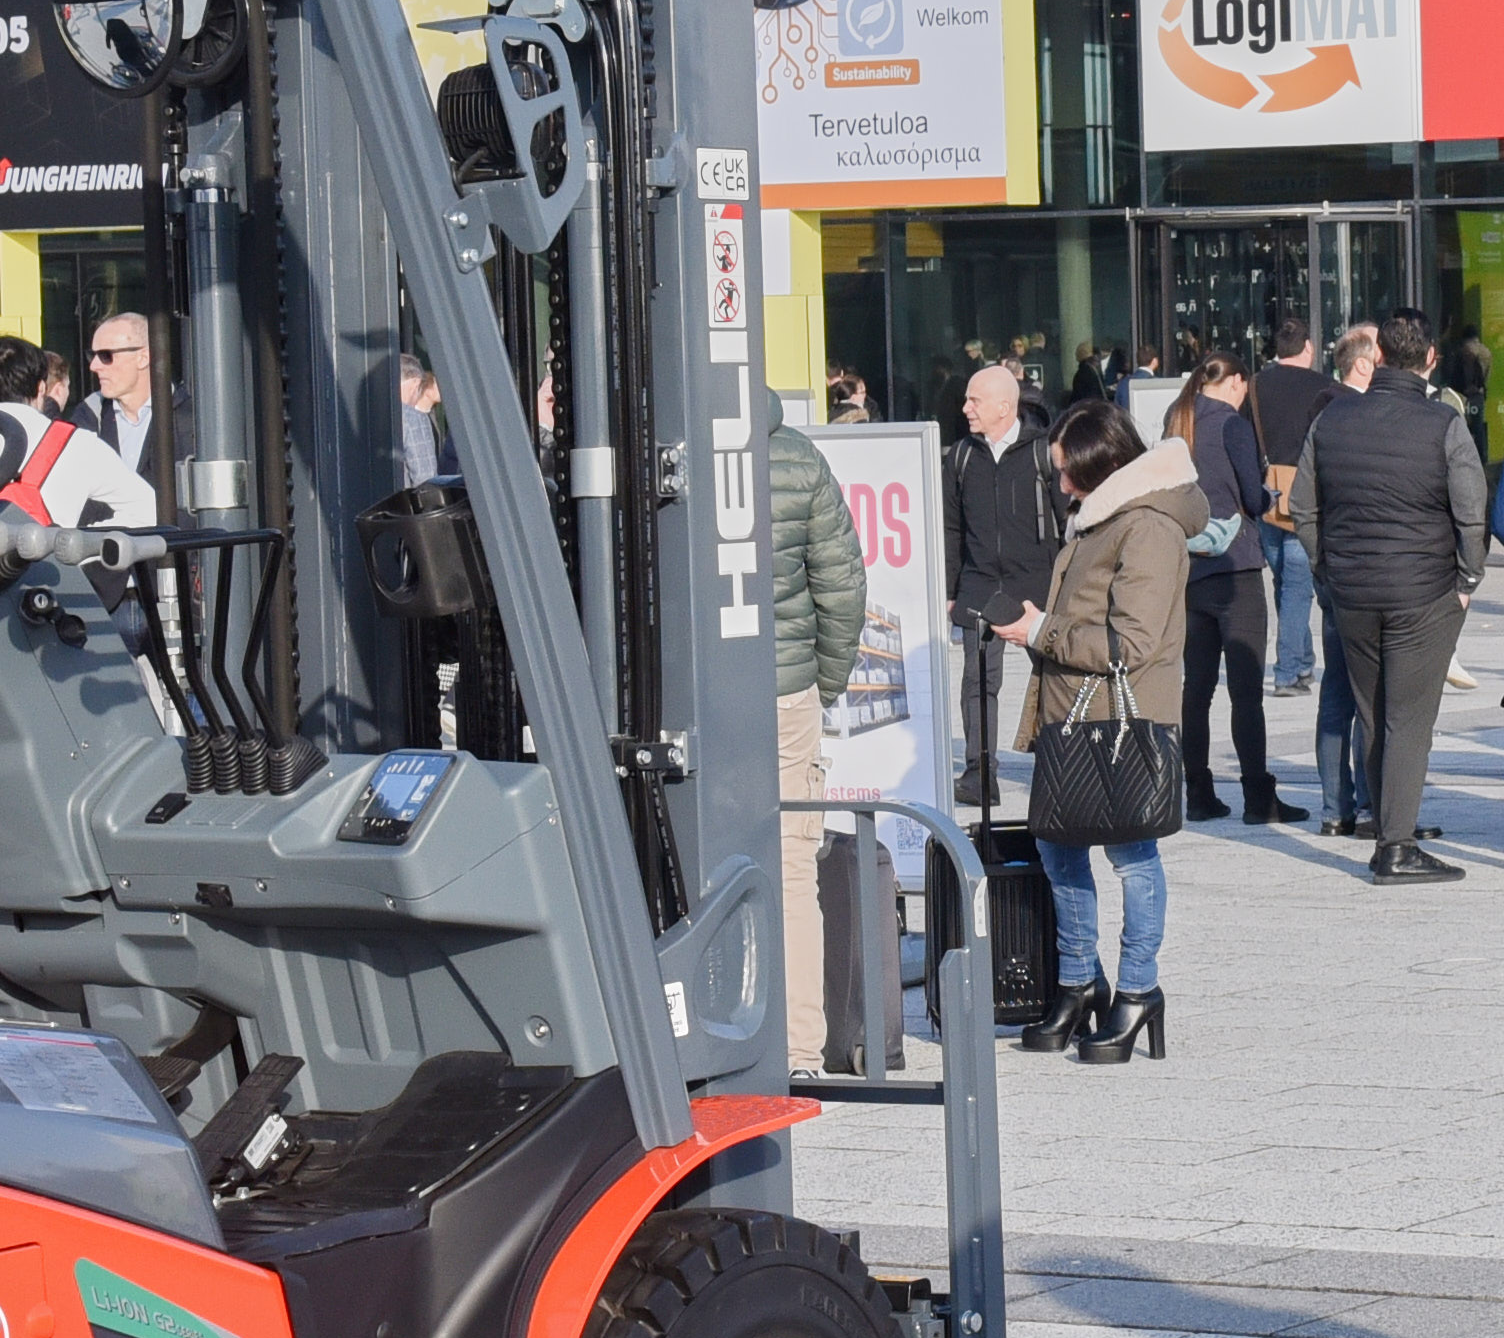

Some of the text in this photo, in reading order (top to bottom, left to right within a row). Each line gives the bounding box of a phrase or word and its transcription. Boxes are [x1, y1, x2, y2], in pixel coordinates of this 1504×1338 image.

[916, 7, 990, 27] Welkom
[832, 64, 912, 83] Sustainability
[809, 111, 929, 138] Tervetuloa
[724, 158, 745, 175] UK
[836, 143, 982, 172] καλωσόρισμα
[725, 175, 746, 192] CA
[709, 331, 760, 639] HELI
